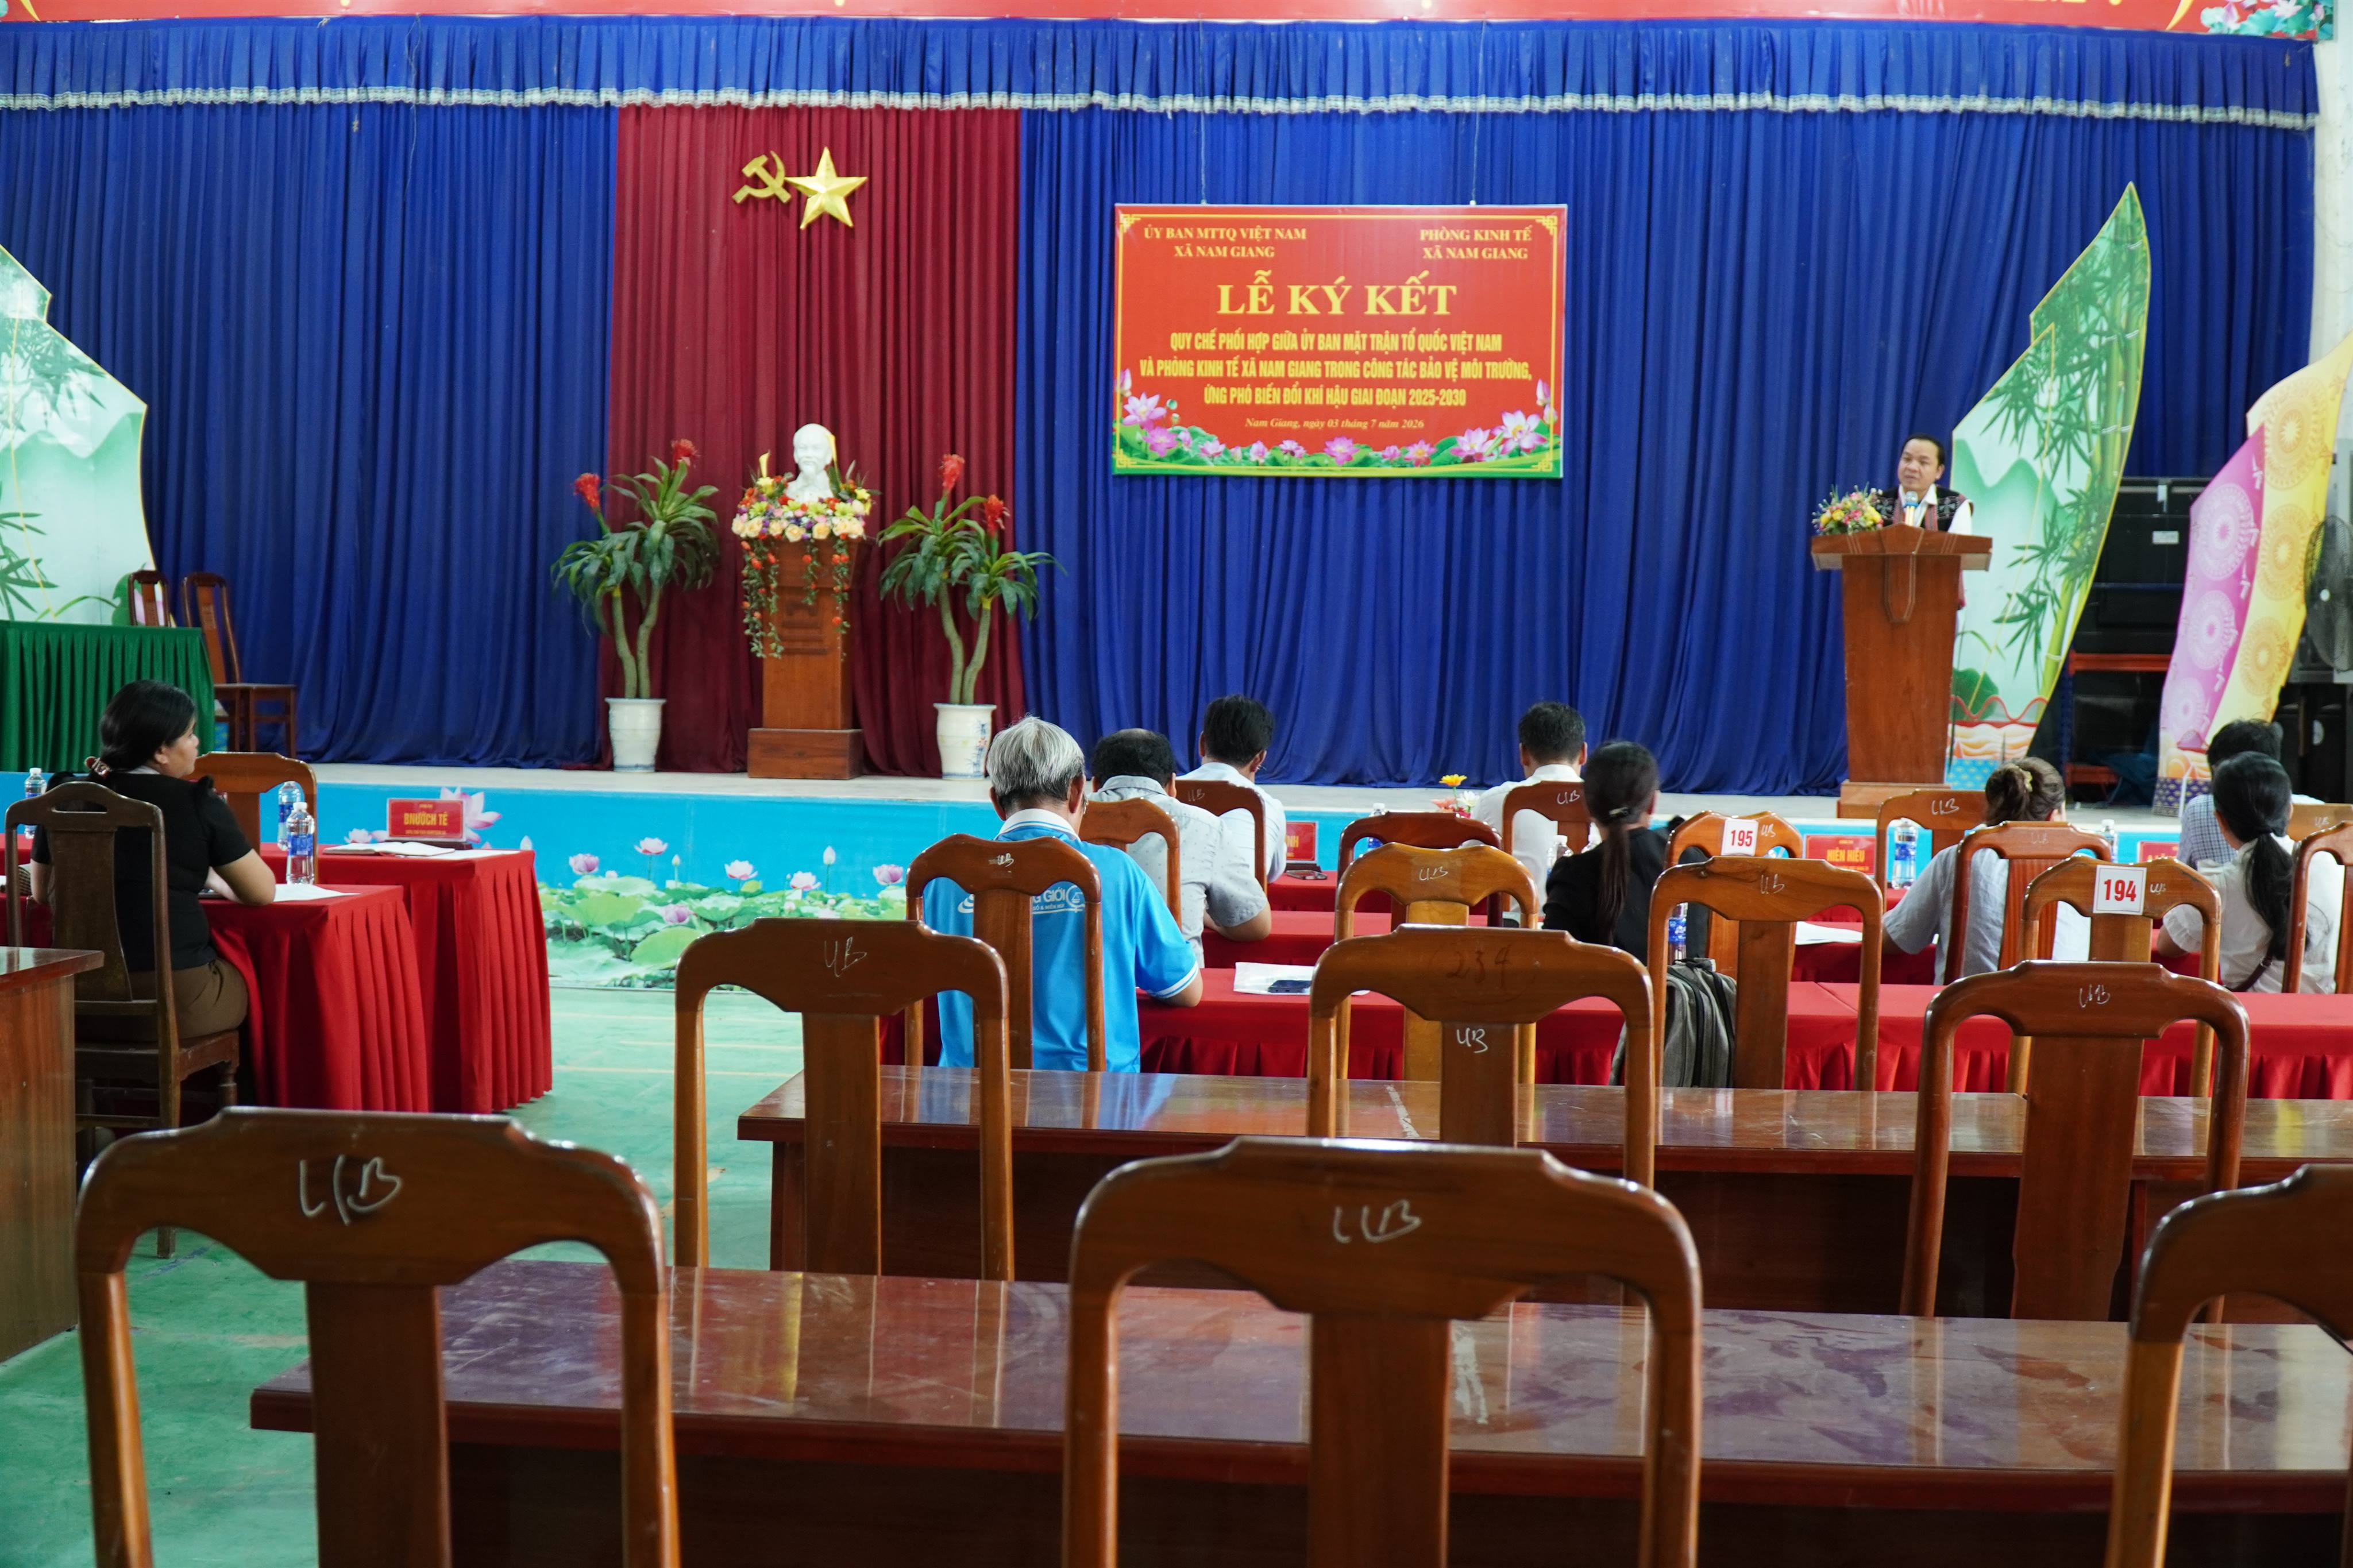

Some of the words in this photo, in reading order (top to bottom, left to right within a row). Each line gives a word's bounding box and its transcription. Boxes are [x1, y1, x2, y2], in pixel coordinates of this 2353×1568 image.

[1144, 224, 1163, 239] ỦY
[1166, 227, 1194, 239] BAN
[1197, 227, 1237, 242] MTTQ
[1240, 225, 1272, 242] VIỆT
[1274, 227, 1307, 240] NAM
[1420, 226, 1471, 241] PHÒNG
[1474, 229, 1511, 241] KINH
[1513, 225, 1533, 241] TẾ
[1174, 243, 1193, 257] XÃ
[1196, 246, 1228, 257] NAM
[1230, 245, 1275, 258] GIANG
[1423, 245, 1443, 259] XÃ
[1445, 247, 1479, 259] NAM
[1481, 247, 1529, 260] GIANG
[1216, 269, 1275, 314] LỄ
[1287, 275, 1352, 315] KÝ
[1363, 270, 1457, 315] KẾT
[1170, 332, 1193, 352] QUY
[1194, 327, 1217, 350] CHẾ
[1218, 327, 1245, 350] PHỐI
[1247, 331, 1270, 354] HỢP
[1272, 330, 1298, 350] GIỮA
[1301, 327, 1316, 350] ỦY
[1317, 333, 1341, 351] BAN
[1343, 330, 1368, 355] MẶT
[1370, 330, 1399, 355] TRẬN
[1401, 327, 1416, 352] TỔ
[1417, 328, 1448, 353] QUỐC
[1449, 330, 1473, 356] VIỆT
[1475, 334, 1502, 352] NAM
[1140, 356, 1154, 377] VÀ
[1156, 356, 1195, 377] PHÒNG
[1197, 360, 1224, 377] KINH
[1226, 355, 1240, 377] TẾ
[1241, 357, 1257, 377] XÃ
[1259, 360, 1285, 377] NAM
[1287, 360, 1322, 378] GIANG
[1324, 361, 1361, 378] TRONG
[1363, 358, 1394, 379] CÔNG
[1395, 358, 1417, 379] TÁC
[1419, 356, 1441, 379] BẢO
[1444, 358, 1459, 383] VỆ
[1461, 358, 1482, 379] MÔI
[1485, 358, 1532, 381] TRƯỜNG,
[1204, 384, 1228, 404] ỨNG
[1229, 384, 1252, 404] PHÓ
[1255, 382, 1281, 404] BIẾN
[1283, 381, 1302, 404] ĐỔI
[1304, 384, 1324, 404] KHÍ
[1326, 384, 1349, 409] HẬU
[1351, 388, 1374, 405] GIAI
[1375, 388, 1406, 409] ĐOẠN
[1409, 388, 1467, 406] 2025-2030
[1245, 418, 1268, 427] Nam
[1270, 418, 1301, 429] Giang,
[1303, 419, 1324, 429] ngày
[1327, 419, 1338, 427] 03
[1341, 419, 1368, 429] tháng
[1371, 419, 1377, 427] 7
[1378, 419, 1398, 428] năm
[1401, 419, 1425, 428] 2026
[1730, 830, 1753, 847] 195
[2104, 879, 2136, 902] 194
[1456, 1027, 1489, 1054] UB
